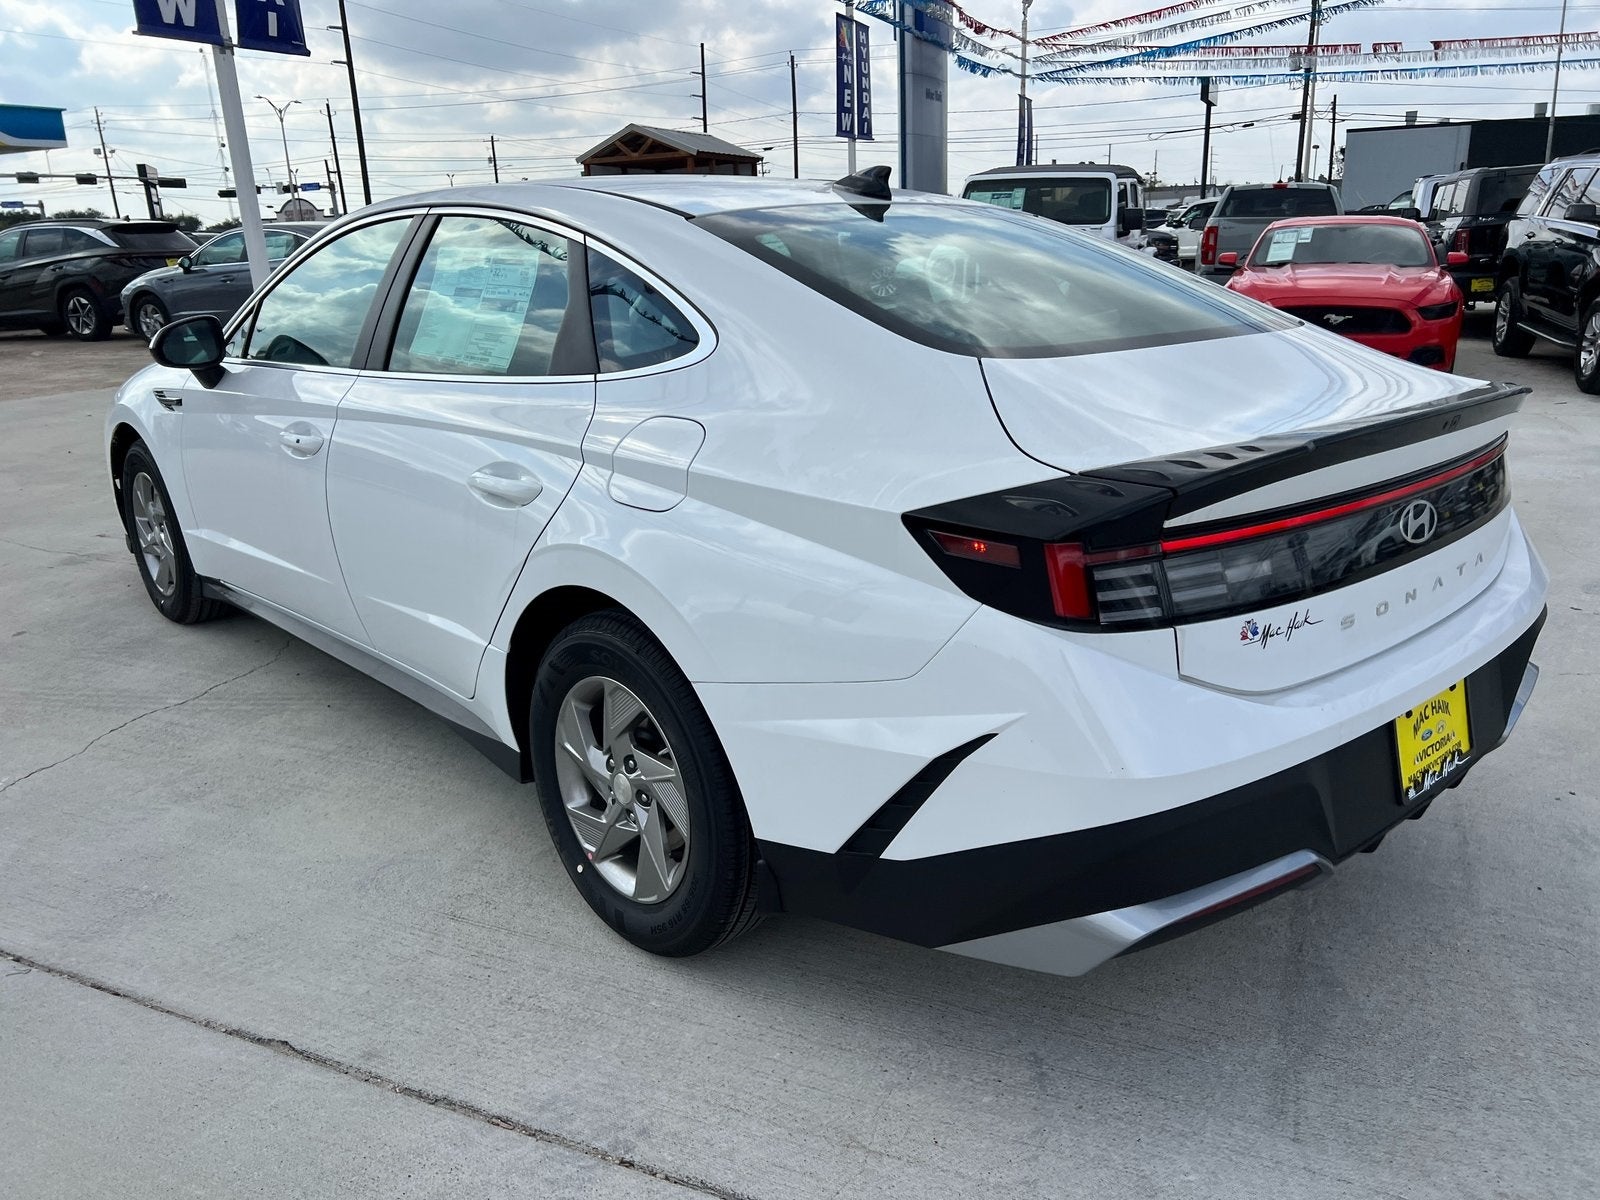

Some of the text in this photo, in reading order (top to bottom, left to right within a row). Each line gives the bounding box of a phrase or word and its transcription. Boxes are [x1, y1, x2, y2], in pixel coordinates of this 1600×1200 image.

[842, 65, 852, 131] NEW
[860, 31, 870, 134] HYUNDAI
[1340, 552, 1484, 631] SONATA
[1254, 623, 1284, 649] Mac
[1413, 703, 1430, 739] MAC
[1431, 699, 1451, 716] HAIK
